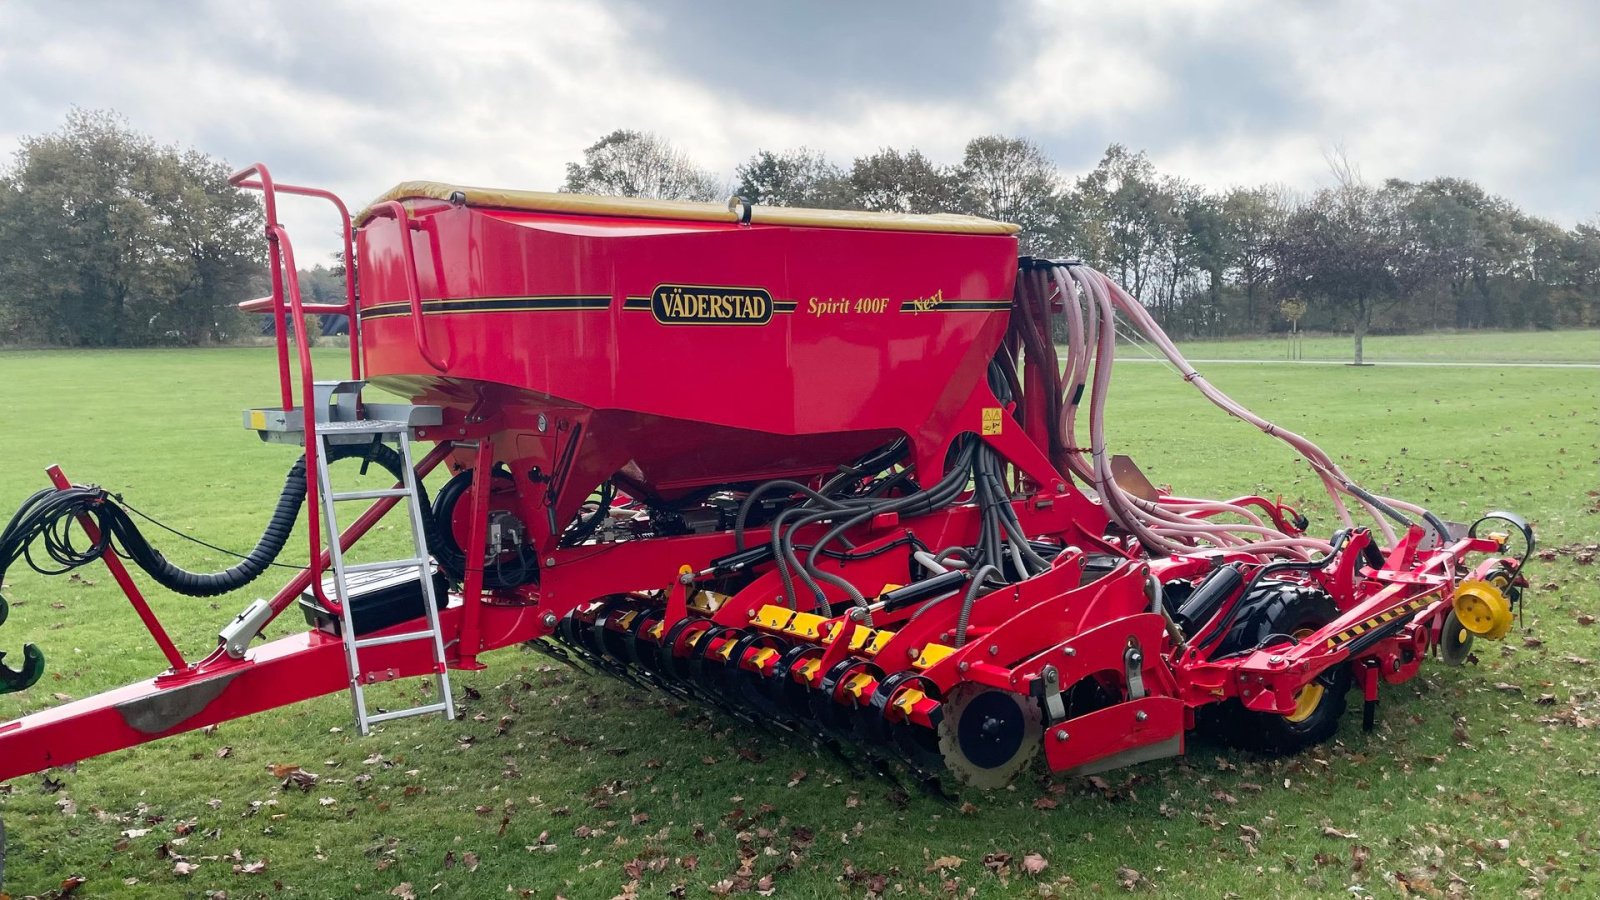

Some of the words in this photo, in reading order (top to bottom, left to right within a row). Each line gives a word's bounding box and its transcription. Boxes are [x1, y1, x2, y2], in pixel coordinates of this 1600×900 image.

[660, 288, 766, 318] VÄDERSTAD
[807, 297, 850, 318] Spirit
[854, 298, 889, 314] 400F
[913, 288, 943, 316] Next
